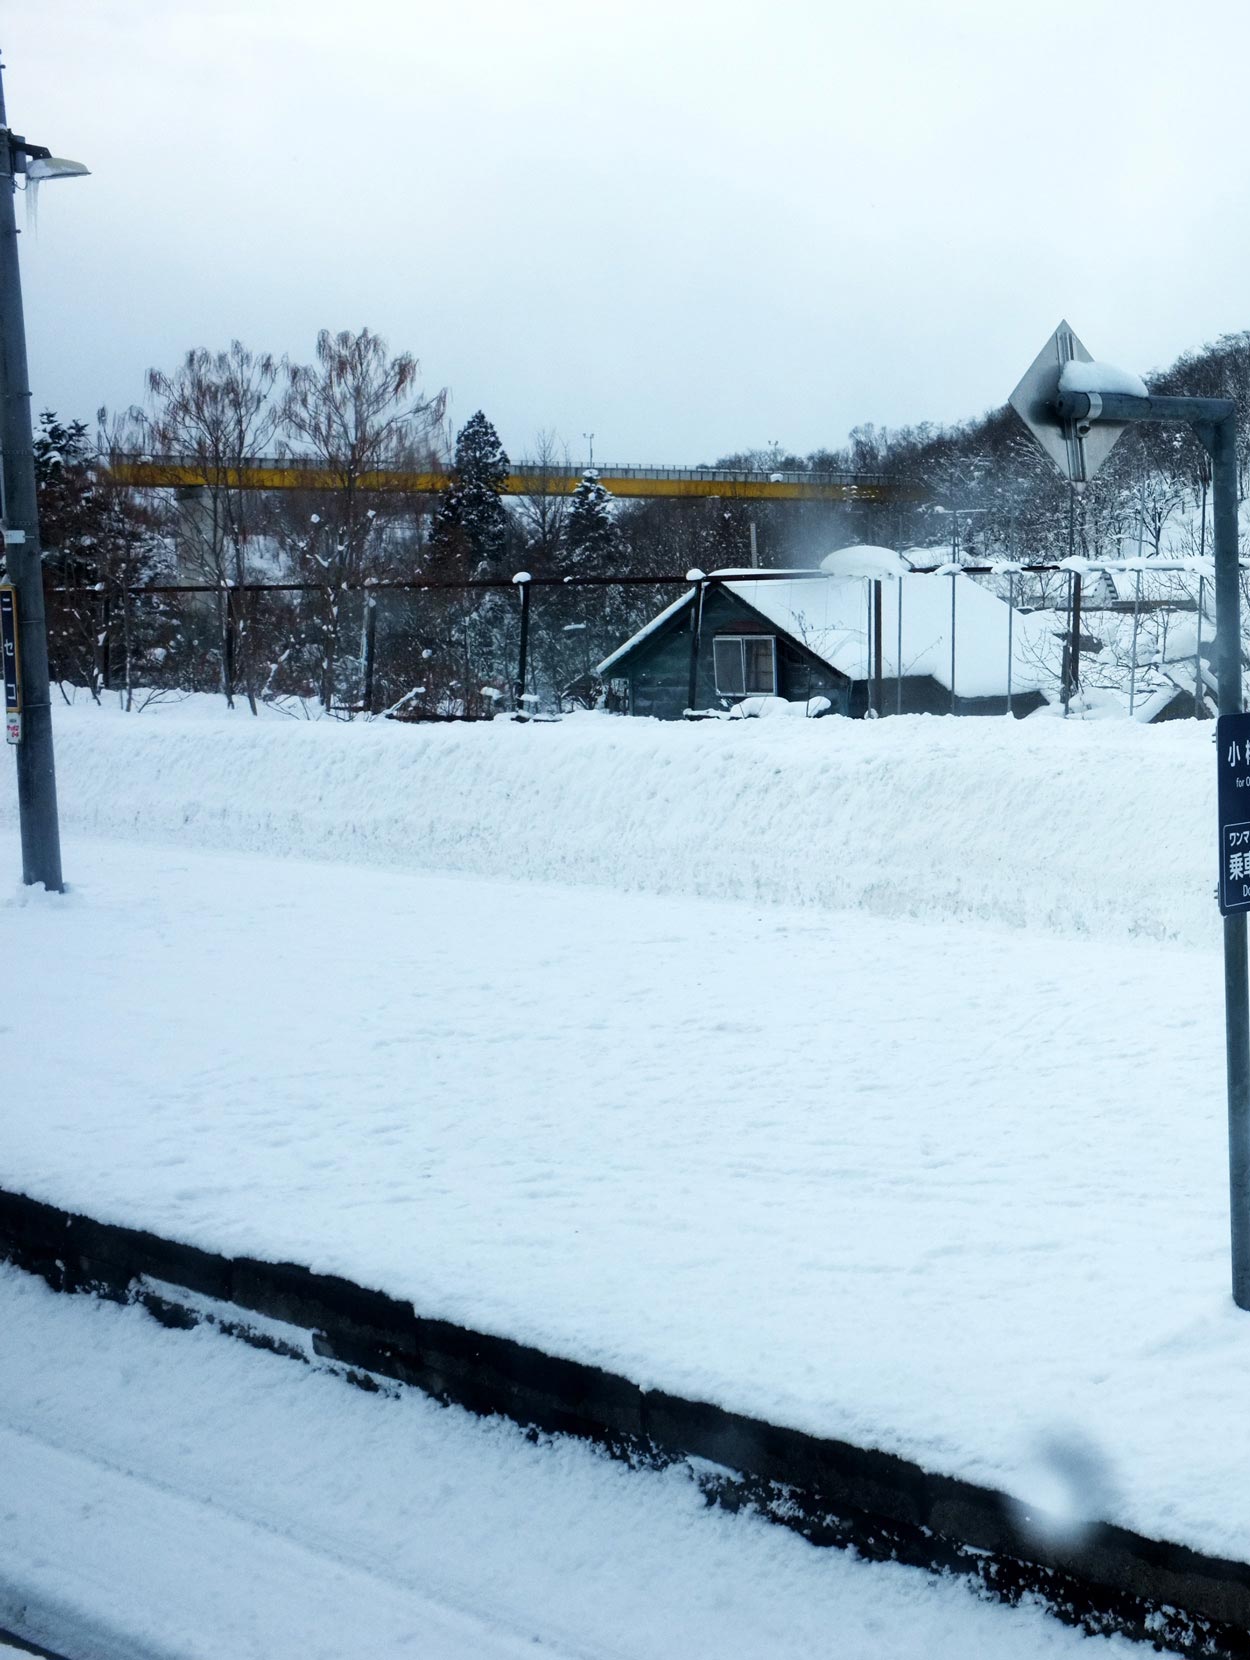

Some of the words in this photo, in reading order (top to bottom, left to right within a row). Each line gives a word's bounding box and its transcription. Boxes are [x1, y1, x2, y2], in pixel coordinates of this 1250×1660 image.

[2, 598, 16, 700] ニセコ
[1236, 777, 1244, 788] for
